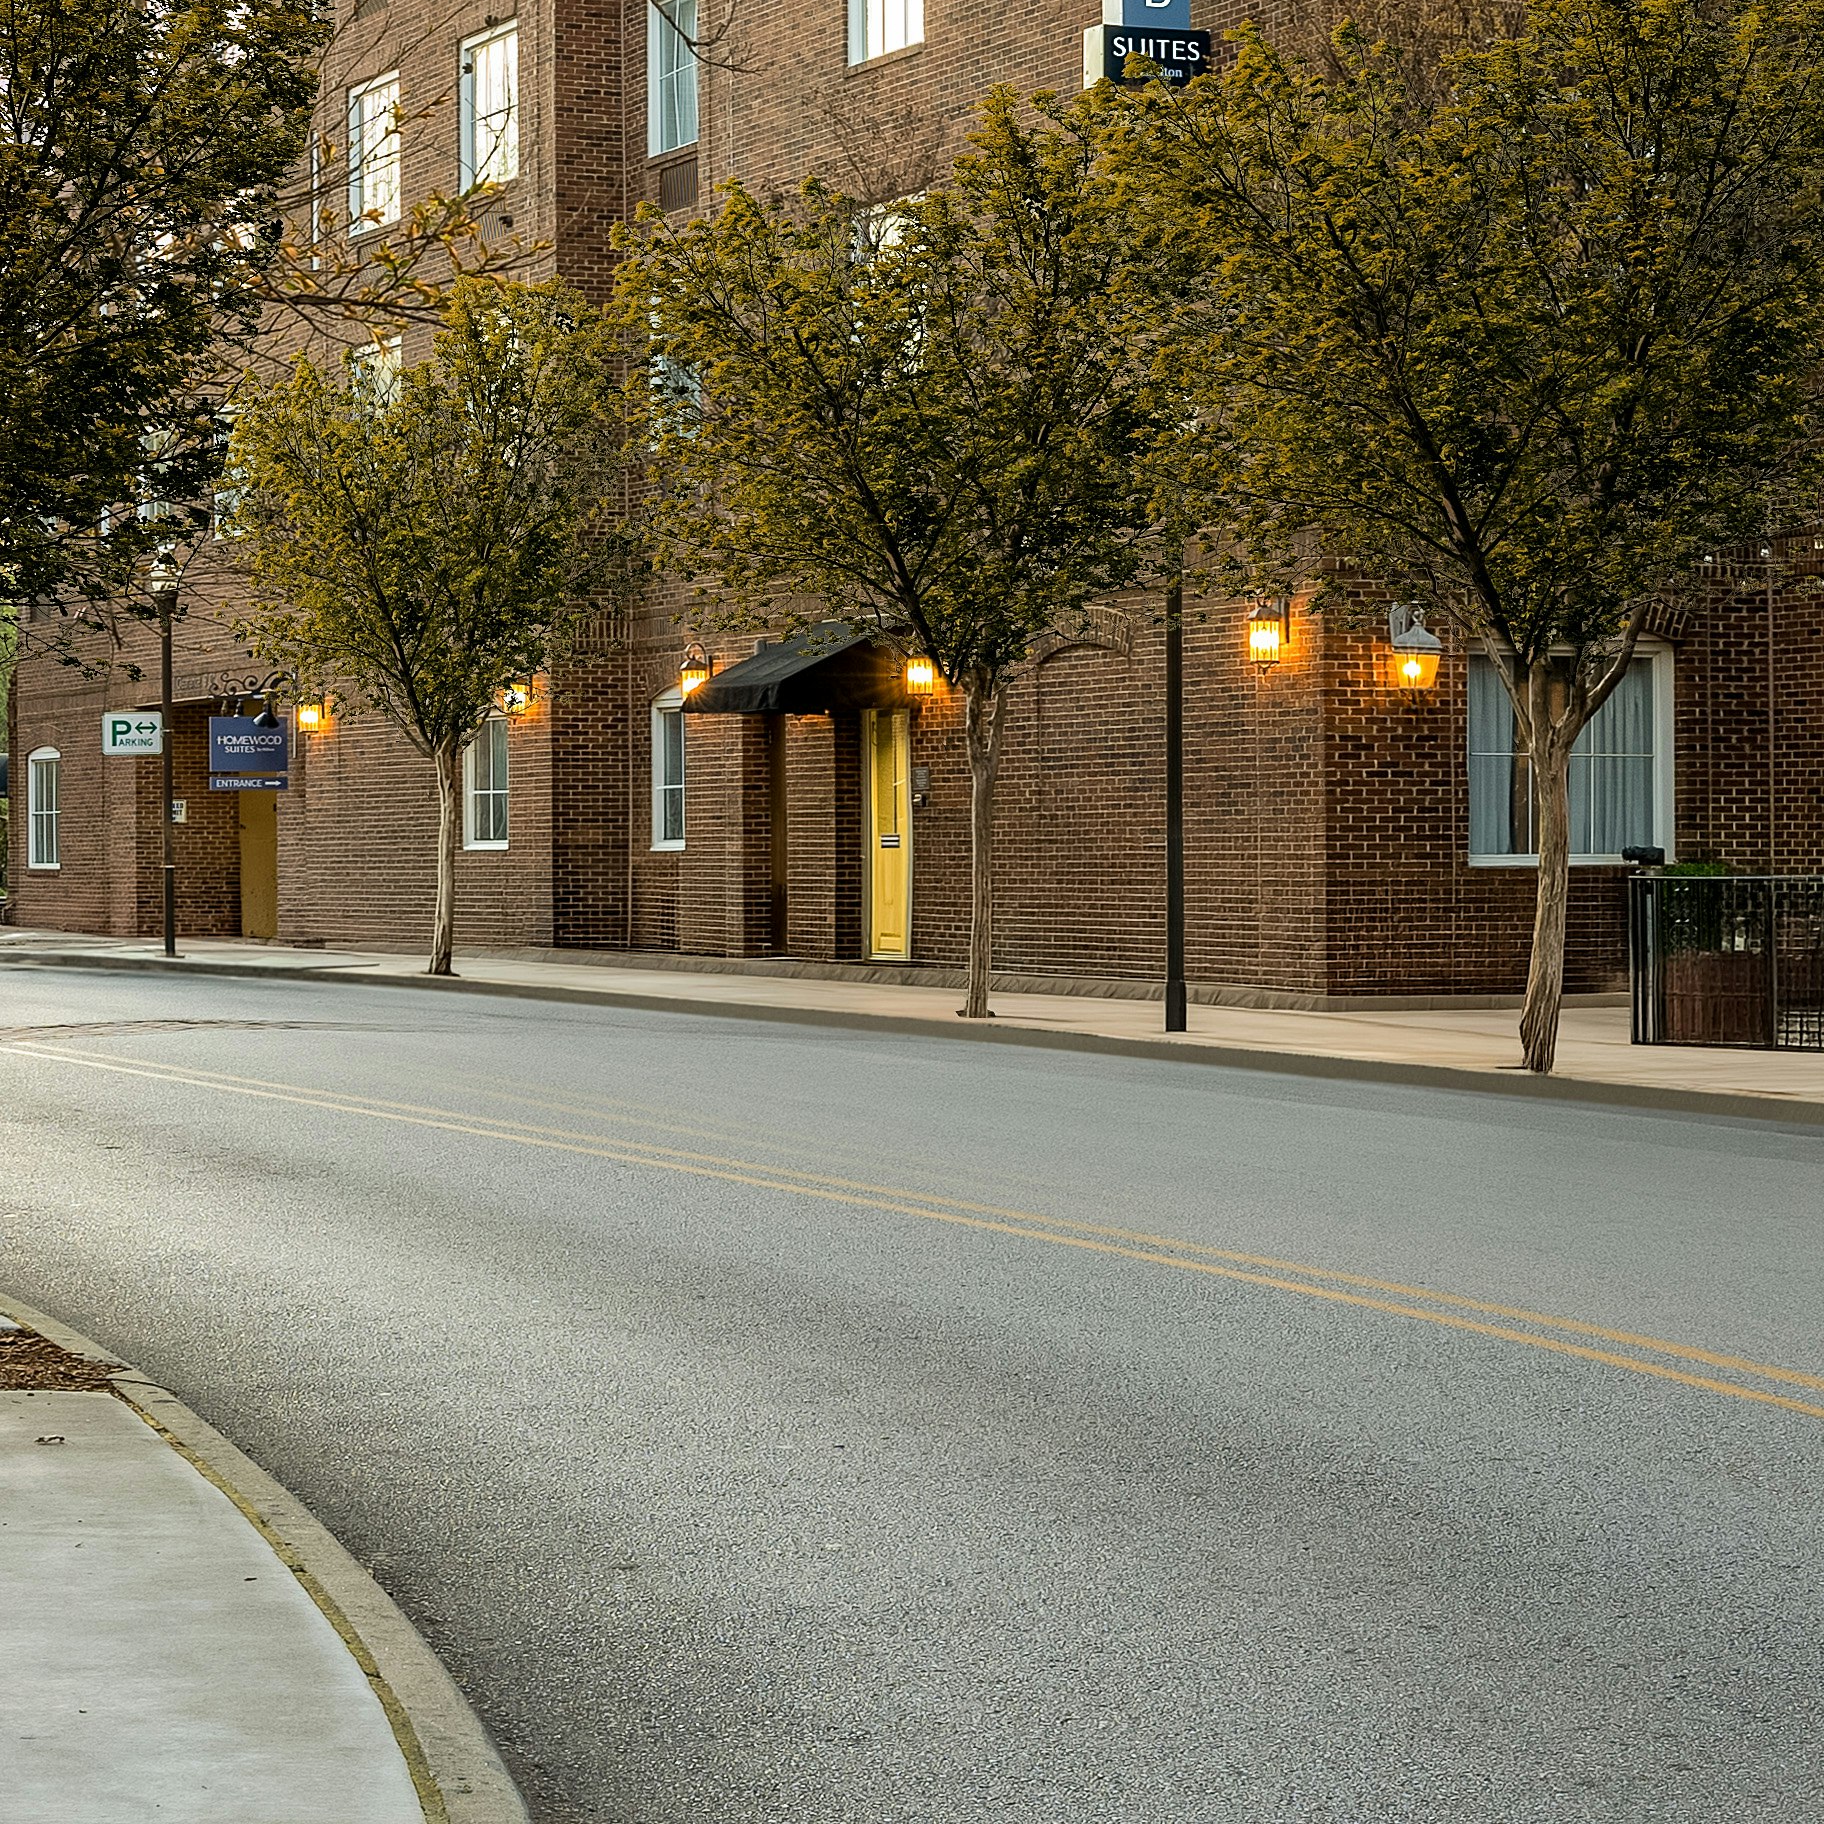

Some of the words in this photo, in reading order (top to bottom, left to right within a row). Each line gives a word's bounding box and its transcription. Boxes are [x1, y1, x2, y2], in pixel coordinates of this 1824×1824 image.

[1113, 36, 1201, 61] SUITES
[217, 735, 283, 745] HOMEWOOD
[224, 745, 256, 754] SUITES
[216, 779, 263, 788] ENTRANCE
